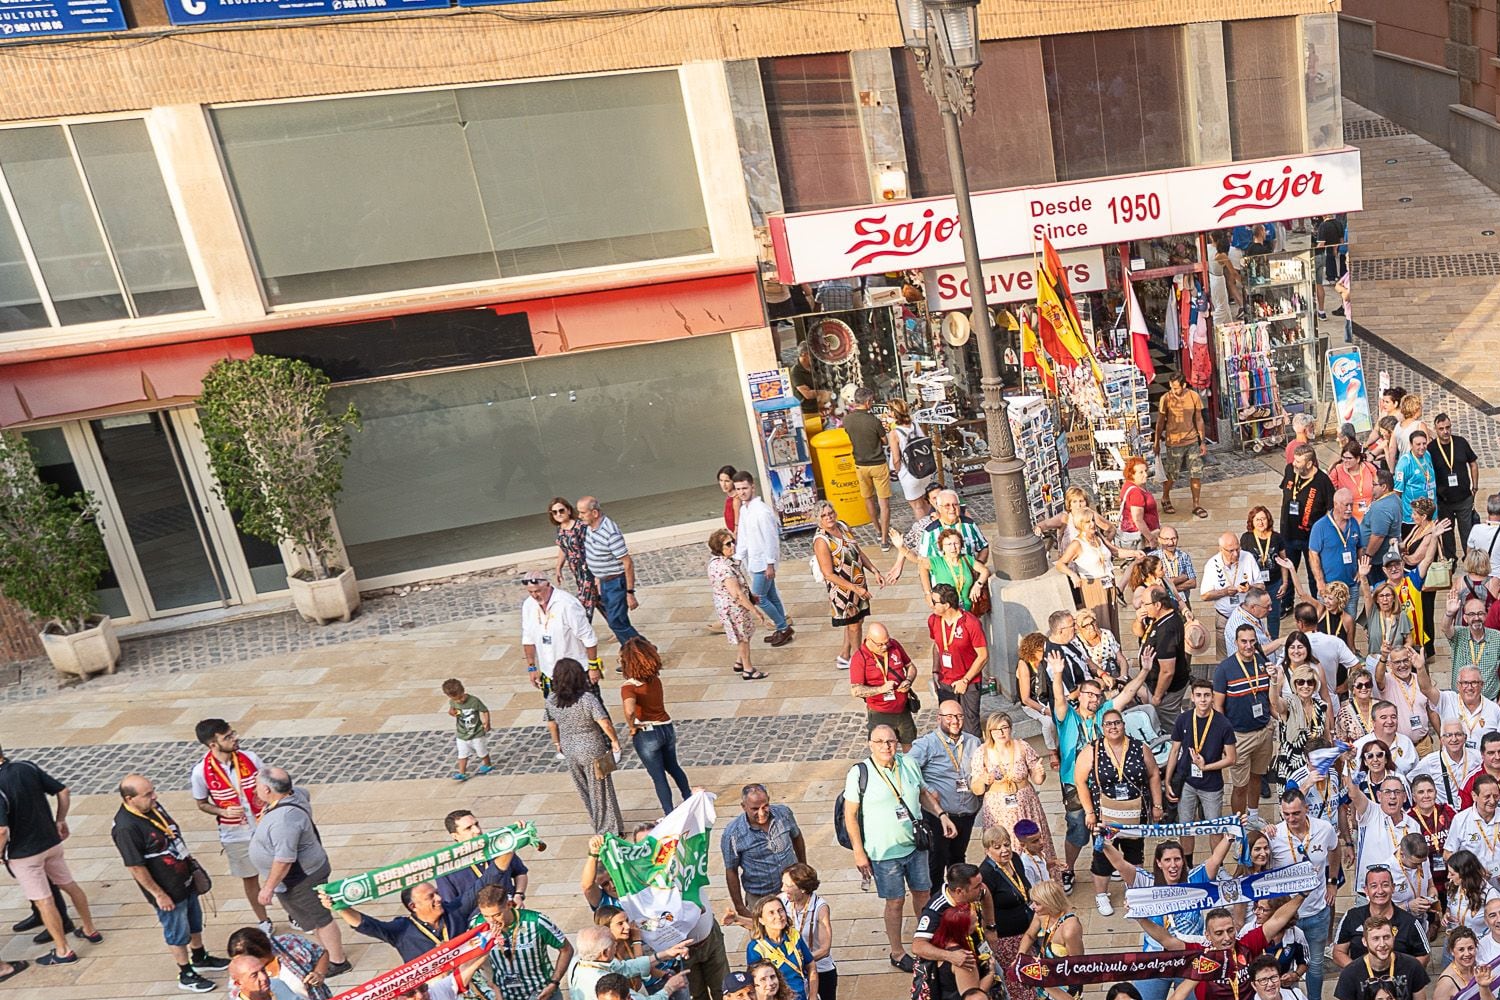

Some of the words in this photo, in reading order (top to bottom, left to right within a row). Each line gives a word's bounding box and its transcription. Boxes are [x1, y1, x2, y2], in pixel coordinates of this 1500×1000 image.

[1212, 165, 1325, 223] Sajor
[1030, 195, 1091, 217] Desde
[1108, 192, 1160, 224] 1950
[845, 209, 963, 271] Sajo
[1033, 223, 1087, 240] Since
[937, 264, 1090, 299] Souvers
[1141, 828, 1192, 837] PARQUE
[1195, 826, 1228, 836] GOYA
[437, 850, 451, 861] DE
[377, 880, 403, 896] REAL
[405, 868, 435, 887] BETIS
[1254, 886, 1270, 898] DE
[364, 947, 450, 990] Sportinguista
[431, 948, 460, 969] SOLO
[1056, 959, 1069, 976] El
[1073, 962, 1127, 973] cachirulo
[1130, 961, 1147, 972] se
